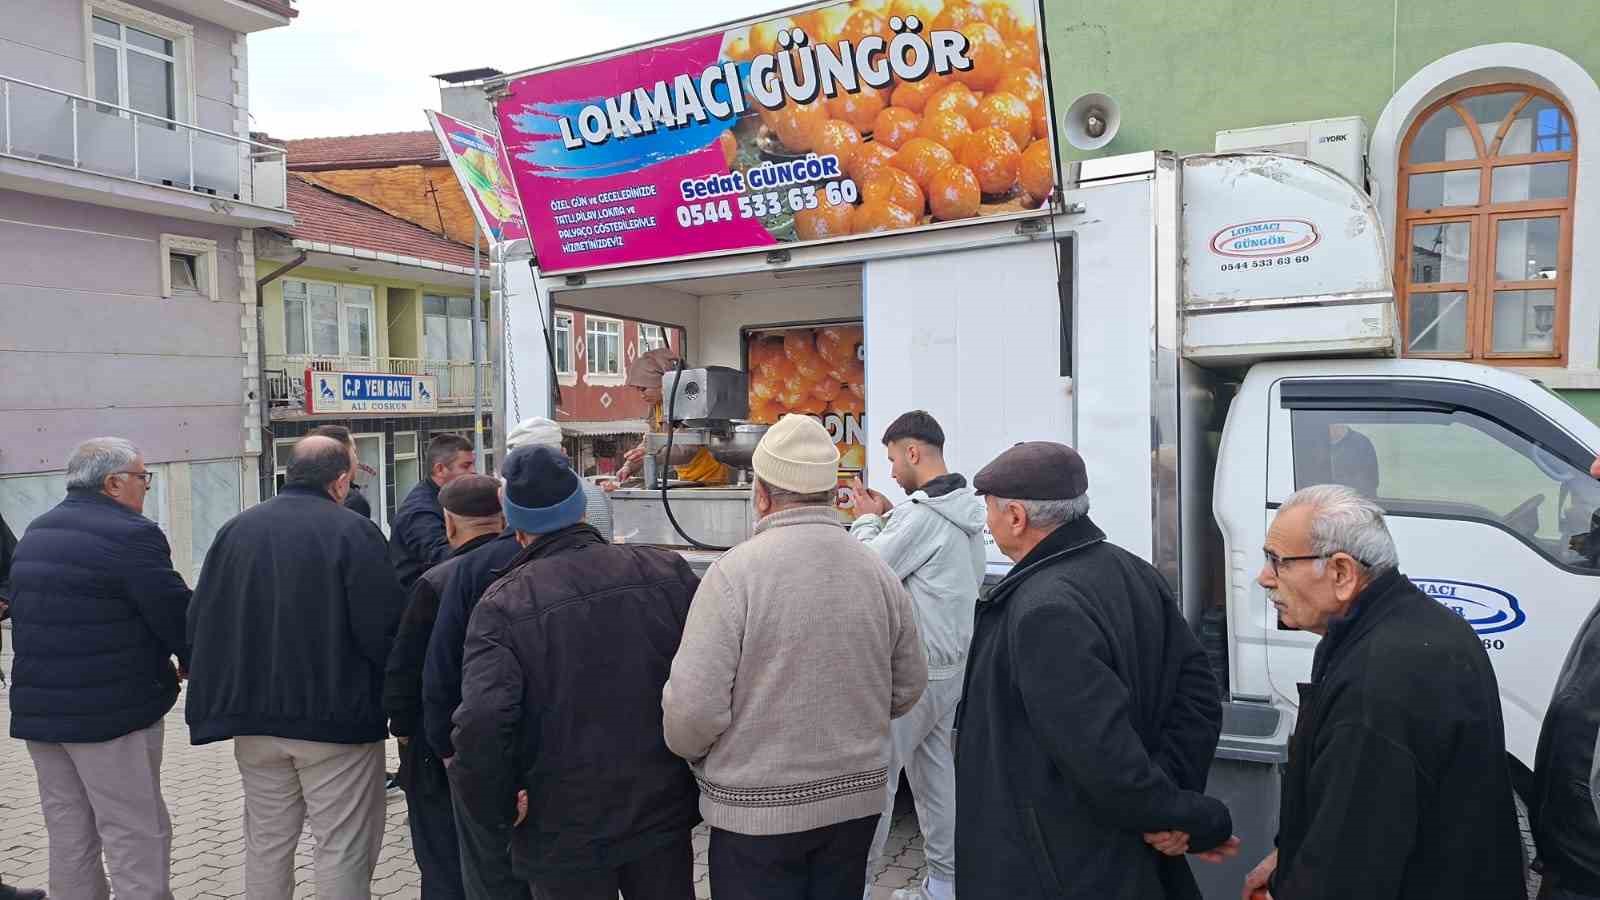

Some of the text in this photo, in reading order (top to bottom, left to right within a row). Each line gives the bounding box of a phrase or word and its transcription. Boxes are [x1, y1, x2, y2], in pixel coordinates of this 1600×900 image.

[559, 15, 974, 150] LOKMACI GÜNGÖR
[1326, 134, 1348, 143] YORK
[681, 154, 841, 200] Sedat GÜNGÖR
[550, 185, 657, 211] ÖZEL GÜN ve GECELERİNİZDE
[676, 179, 858, 228] 0544 533 63 60
[627, 206, 636, 215] ve
[558, 225, 593, 240] PALYAÇO
[1231, 223, 1281, 237] LOKMACI
[1234, 234, 1286, 250] GÜNGÖR
[1221, 255, 1310, 272] 0544 533 63 60
[364, 379, 384, 397] YEM
